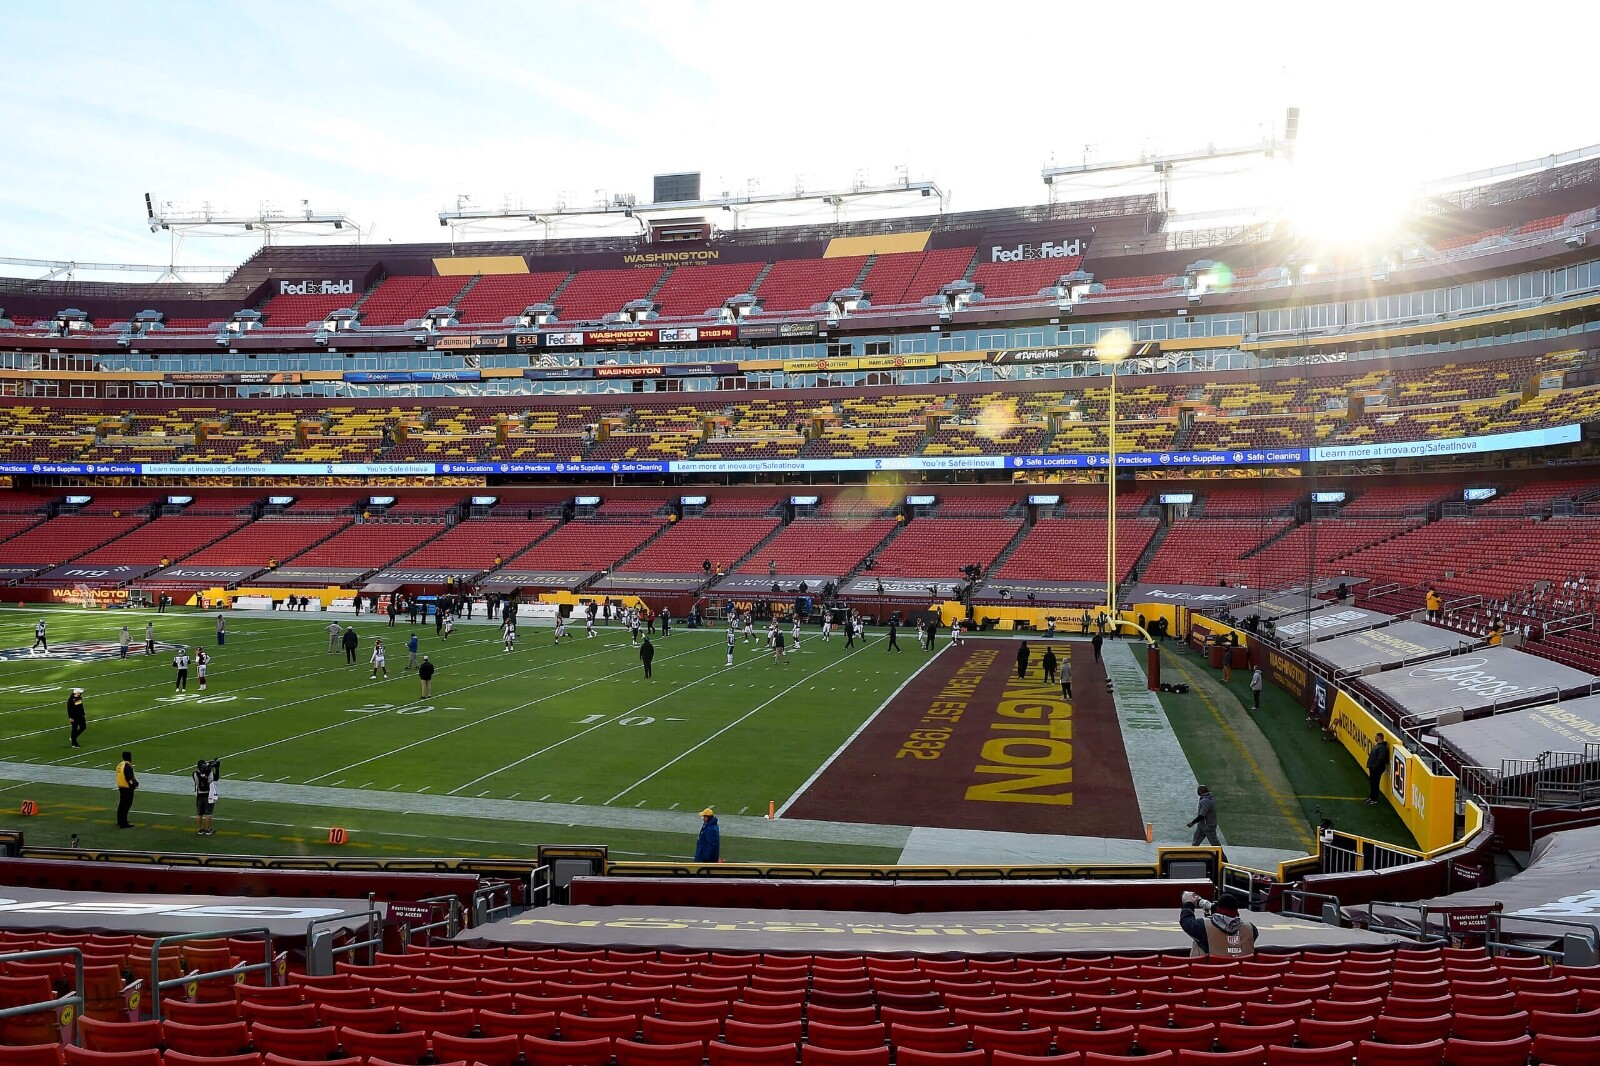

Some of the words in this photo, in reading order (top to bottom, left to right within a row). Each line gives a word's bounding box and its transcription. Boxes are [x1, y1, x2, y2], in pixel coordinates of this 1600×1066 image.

[992, 239, 1079, 262] FedExField
[623, 250, 719, 263] WASHINGTON
[280, 279, 353, 295] FedExField
[589, 331, 653, 339] WASHINGTON
[660, 331, 691, 341] FedEx
[700, 329, 721, 338] 3:11:03
[443, 338, 476, 346] BURGUNDY
[516, 335, 537, 345] 53:58
[547, 334, 578, 345] FedEx
[432, 371, 459, 380] AQUAFINA
[598, 367, 661, 376] WASHINGTON
[1320, 449, 1346, 458] Learn
[1373, 446, 1382, 454] at
[1383, 440, 1477, 456] inova.org/SafeatInova
[1173, 455, 1190, 463] Safe
[1192, 455, 1225, 464] Supplies
[1267, 452, 1300, 461] Cleaning
[0, 465, 27, 473] Practices
[43, 465, 55, 473] Safe
[56, 465, 81, 474] Supplies
[96, 465, 110, 473] Safe
[110, 465, 136, 474] Cleaning
[149, 465, 168, 473] Learn
[366, 465, 387, 473] You're
[510, 464, 523, 472] Safe
[524, 464, 551, 472] Practices
[566, 464, 579, 472] Safe
[580, 464, 606, 473] Supplies
[621, 463, 634, 471] Safe
[636, 463, 662, 472] Cleaning
[65, 569, 110, 578] nrg
[987, 584, 1108, 593] WASHINGTON
[953, 649, 999, 675] FOOTBALL
[1269, 651, 1306, 689] WASHINGTON
[931, 675, 982, 700] TEAM,
[154, 693, 238, 705] 30
[344, 703, 435, 715] 20
[920, 701, 967, 724] EST.
[1123, 703, 1158, 715] OF
[569, 714, 656, 727] 10
[1126, 717, 1165, 730] US
[894, 726, 956, 761] 1932
[21, 800, 34, 816] 20
[331, 828, 343, 843] 10
[0, 897, 346, 920] GEI
[980, 920, 1178, 928] OOTBALL
